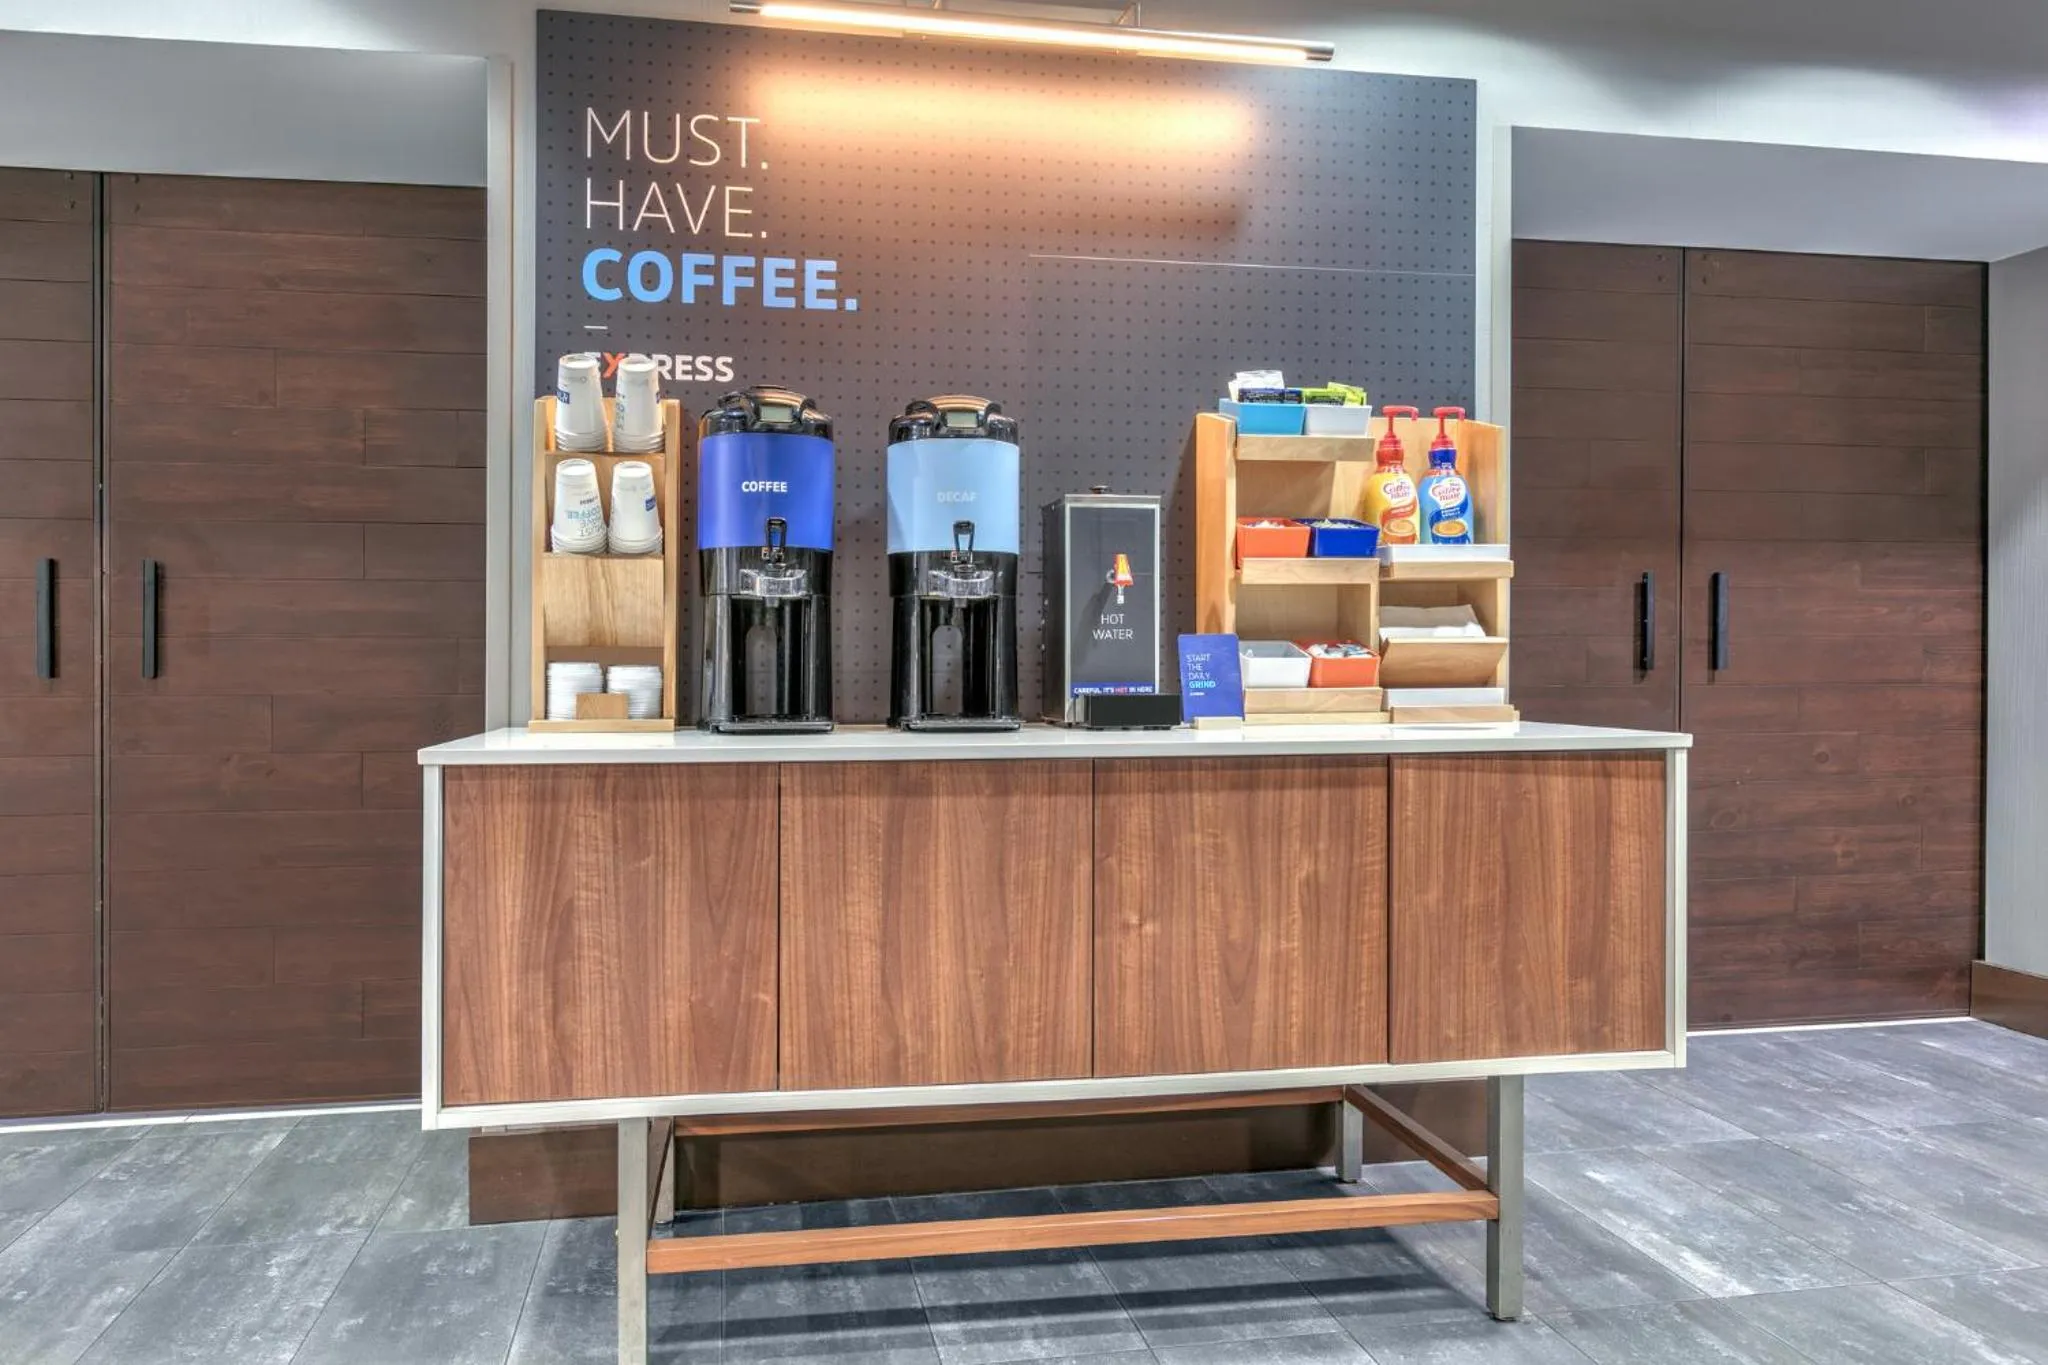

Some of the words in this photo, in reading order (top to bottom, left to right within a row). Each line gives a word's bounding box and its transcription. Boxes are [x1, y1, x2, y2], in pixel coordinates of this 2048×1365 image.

[586, 106, 769, 170] MUST.
[586, 177, 768, 239] HAVE.
[581, 247, 859, 311] COFFEE.
[584, 351, 734, 382] XRESS
[741, 480, 788, 493] COFFEE
[936, 490, 978, 502] DECAF
[1100, 613, 1125, 625] HOT
[1092, 628, 1134, 640] WATER
[1186, 653, 1211, 662] START
[1187, 663, 1203, 671] THE
[1189, 680, 1216, 689] GRIND
